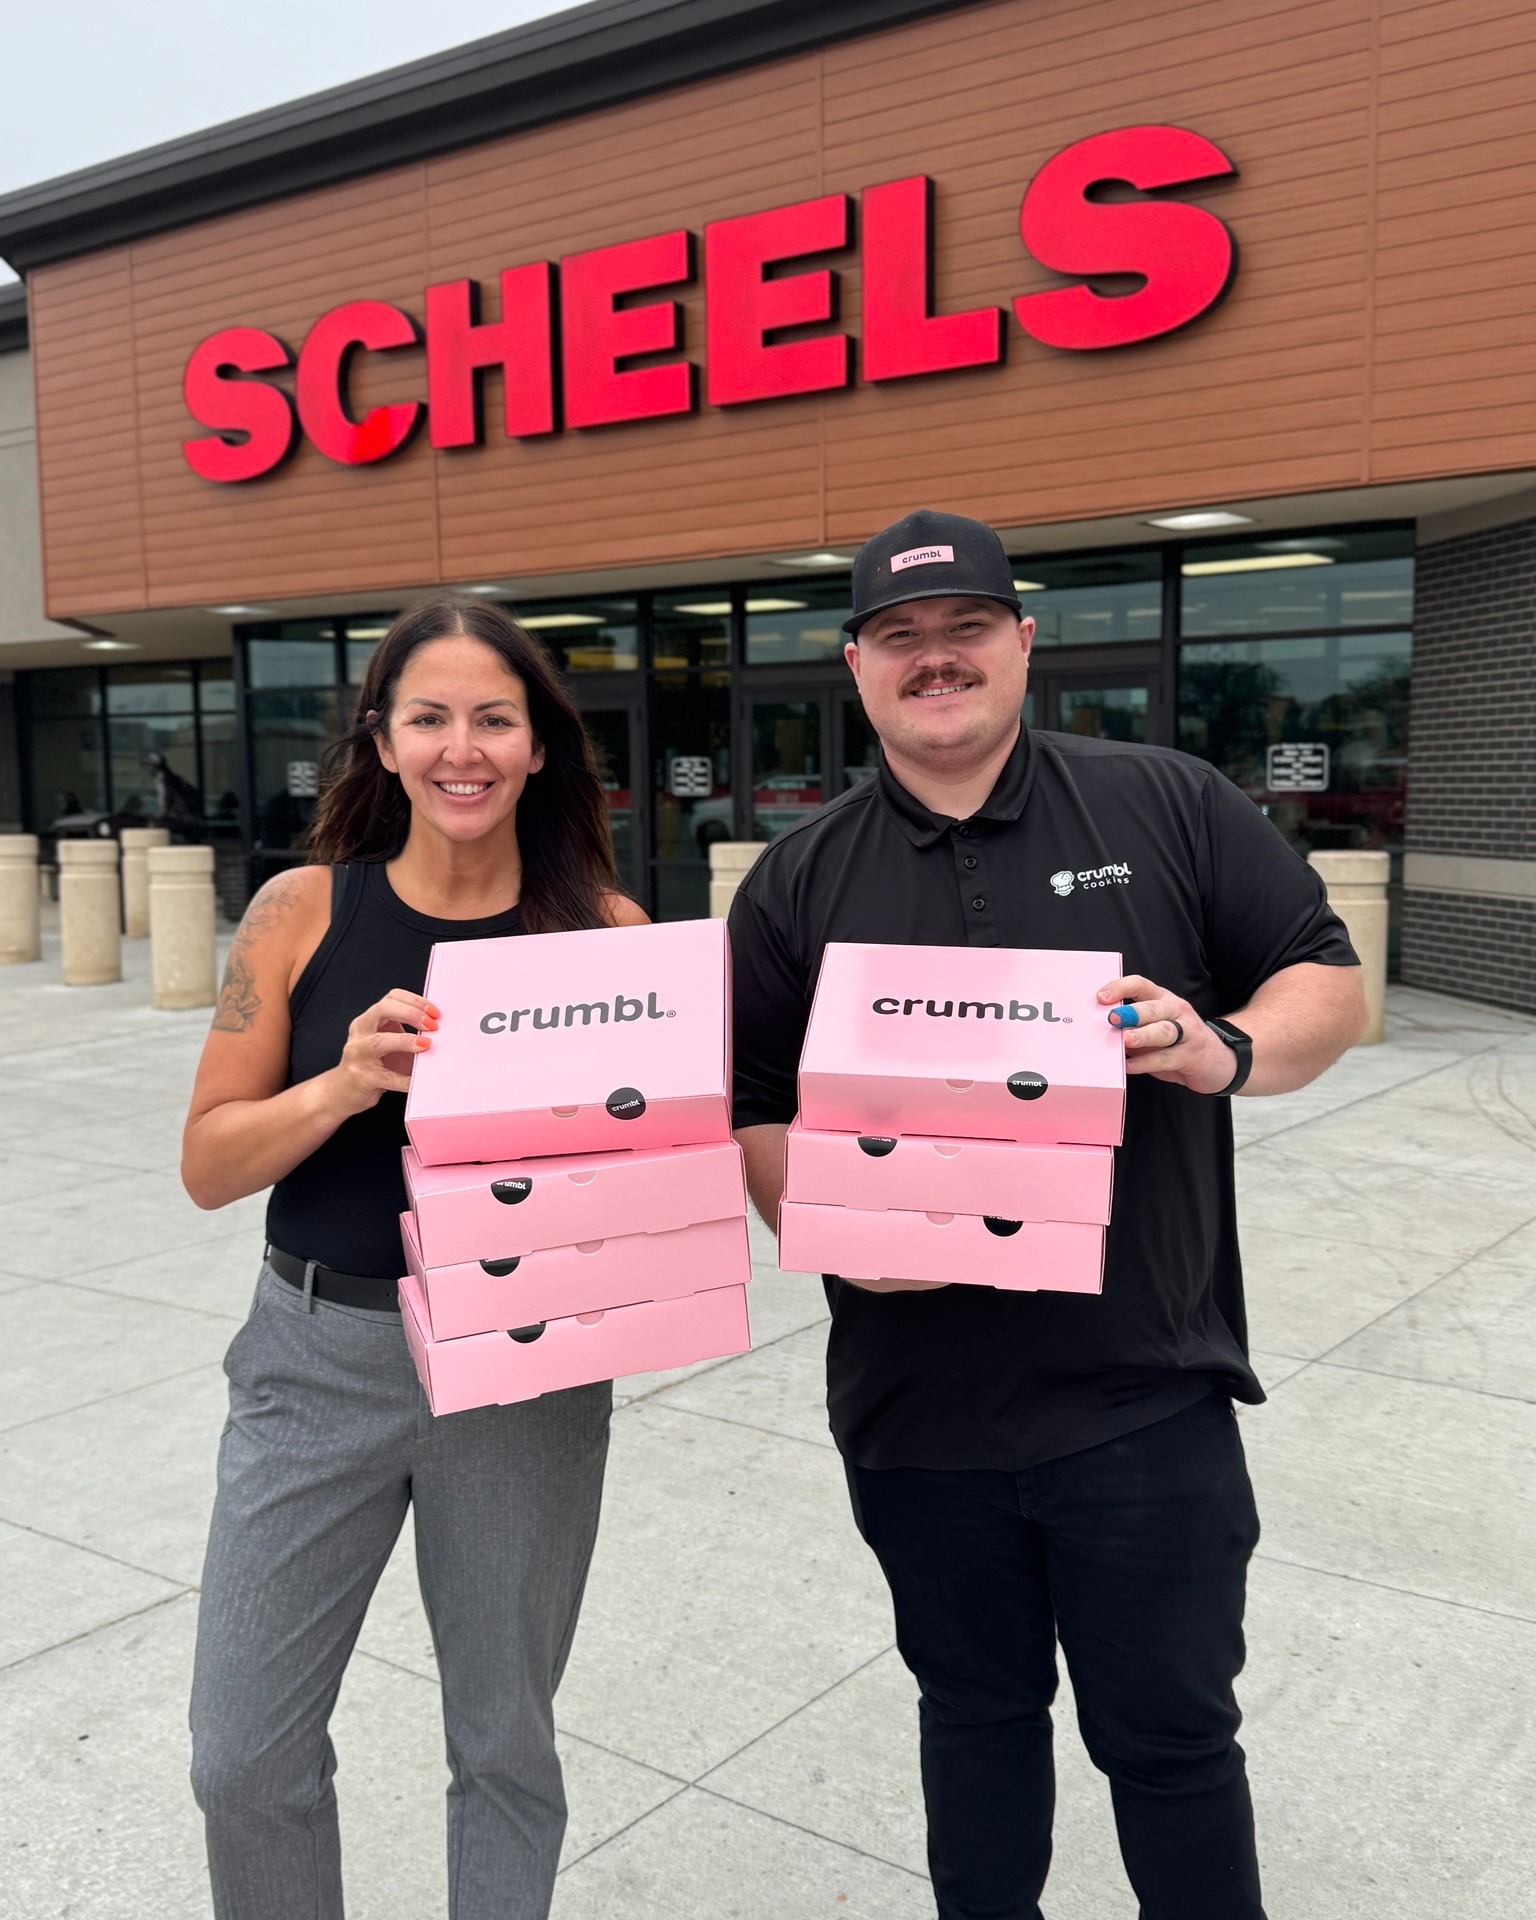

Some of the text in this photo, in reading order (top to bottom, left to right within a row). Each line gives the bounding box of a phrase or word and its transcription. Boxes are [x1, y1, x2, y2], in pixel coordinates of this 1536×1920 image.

[183, 124, 1237, 483] SCHEELS
[902, 550, 942, 564] crumbl
[1077, 862, 1132, 882] crumbl
[1083, 876, 1130, 890] cookies
[612, 1099, 641, 1112] crumbl
